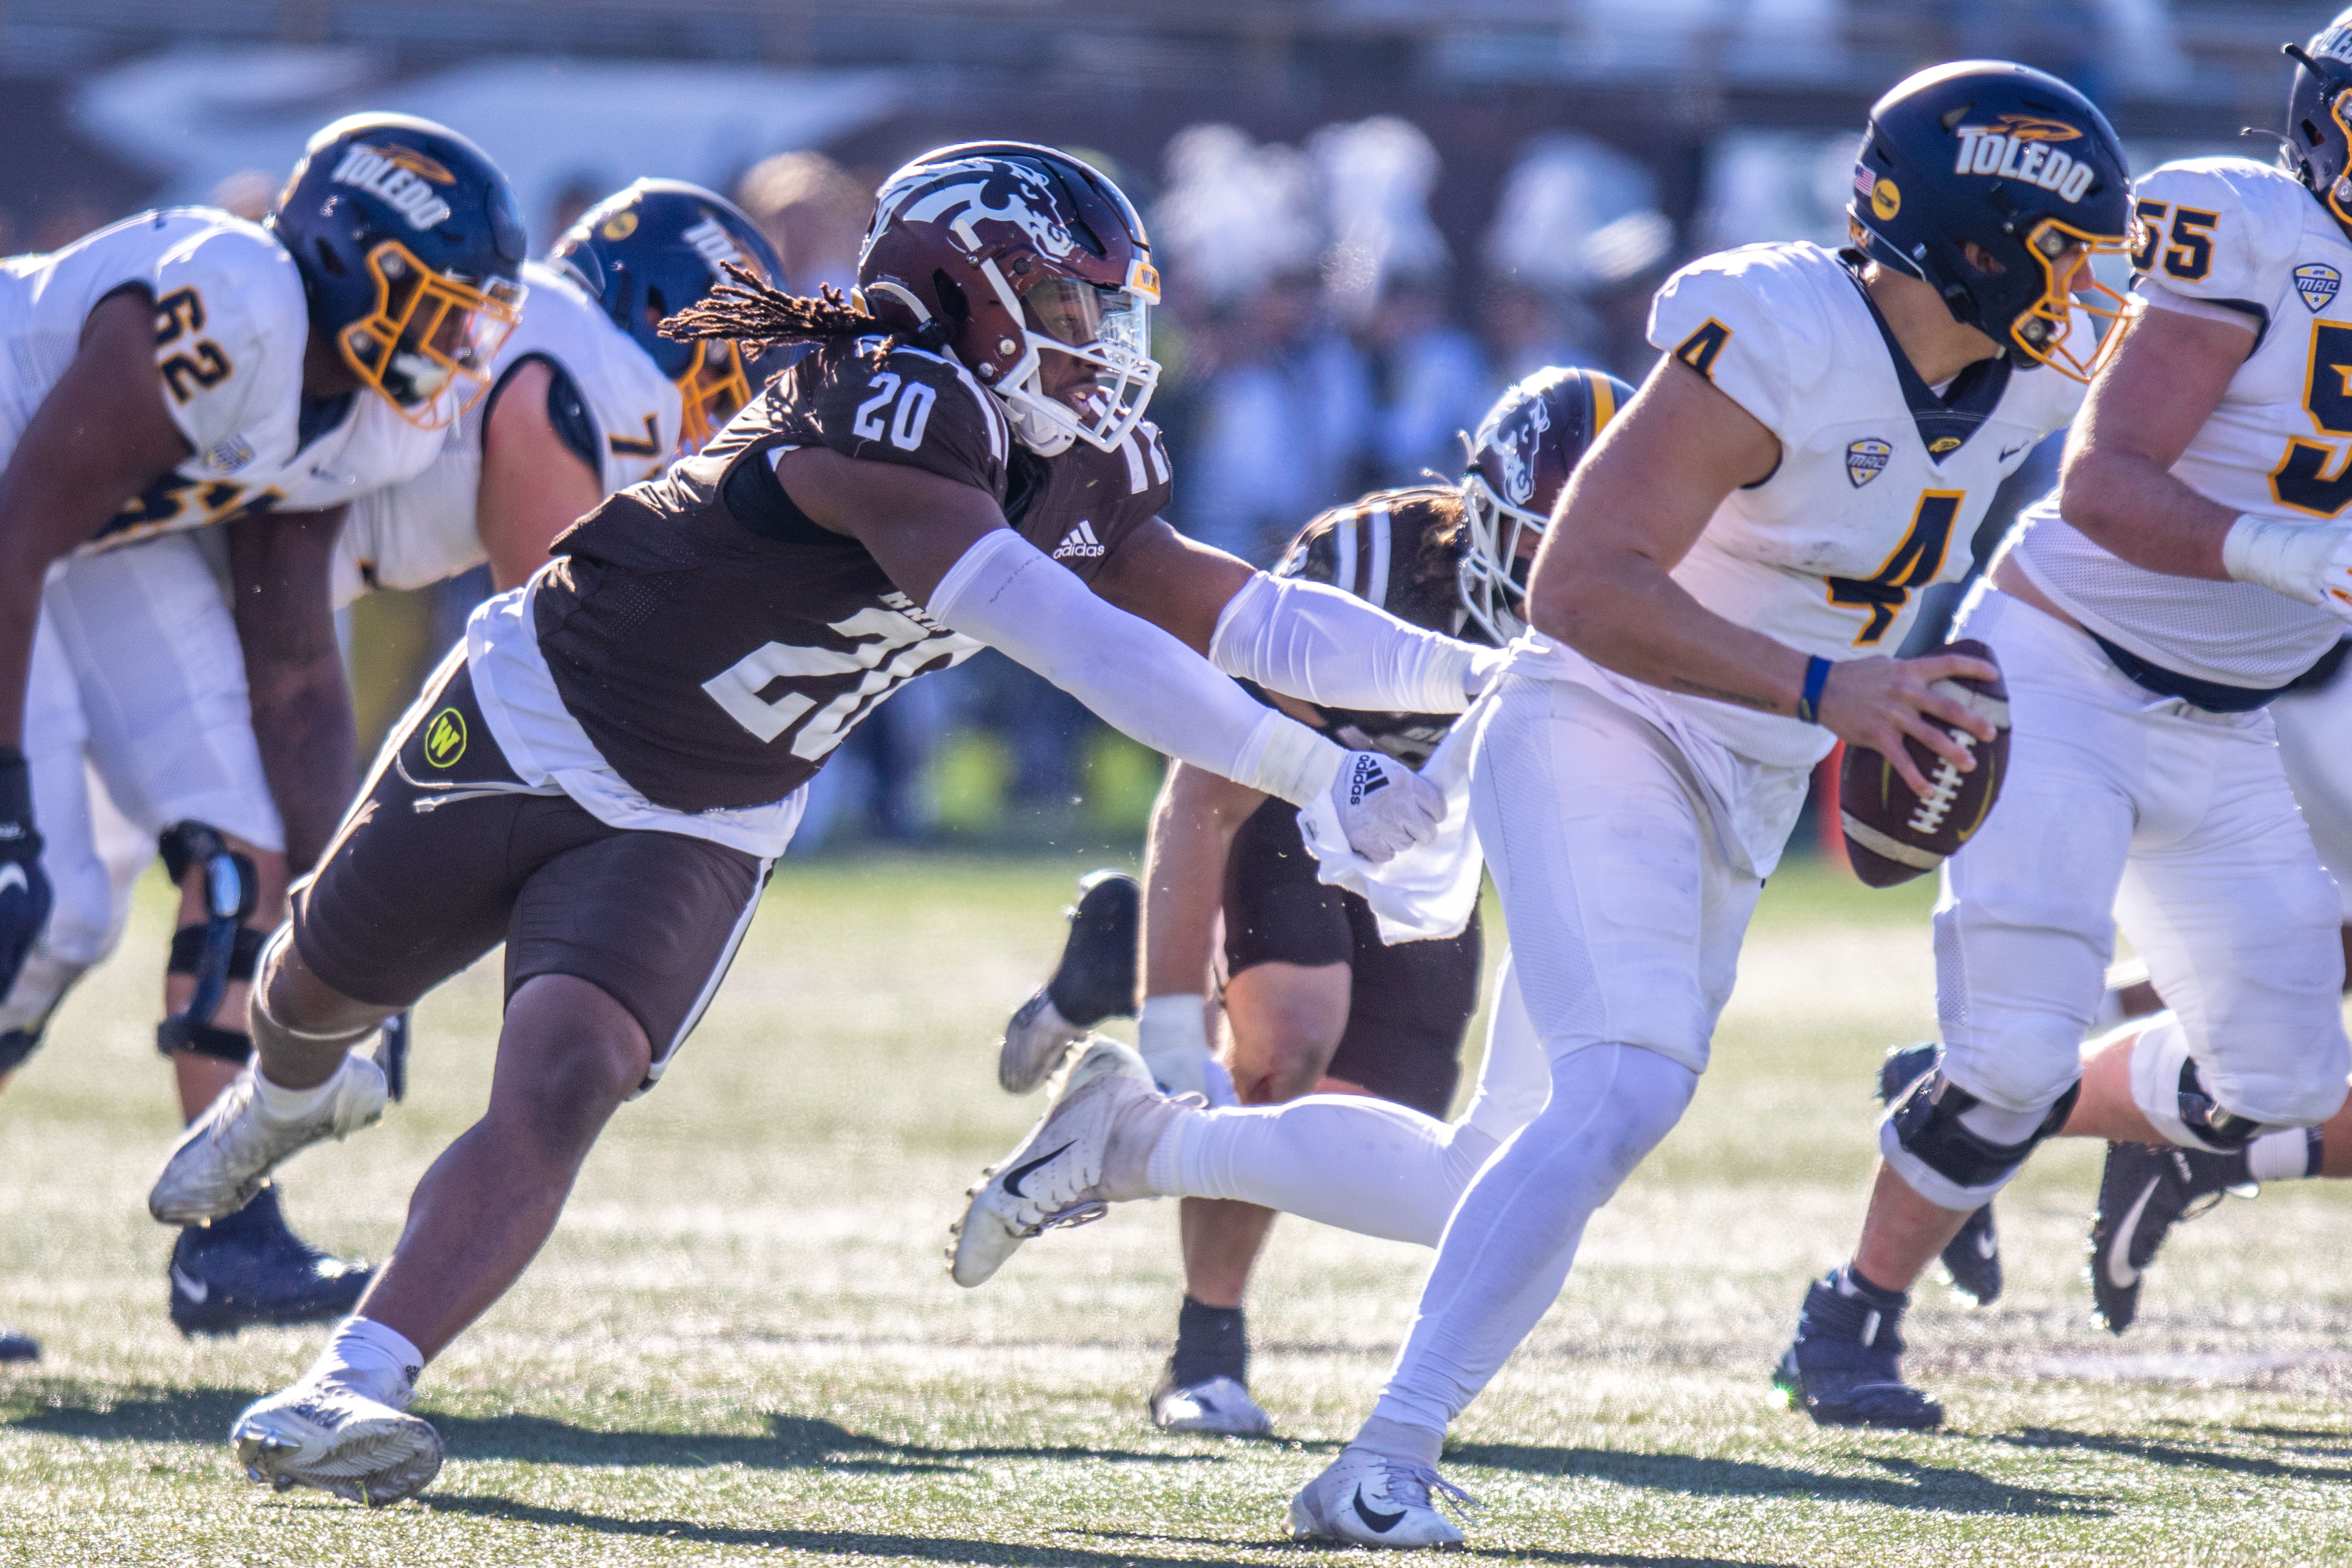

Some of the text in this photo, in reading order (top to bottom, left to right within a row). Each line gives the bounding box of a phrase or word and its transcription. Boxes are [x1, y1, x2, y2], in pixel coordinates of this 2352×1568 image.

[331, 143, 451, 231] TOLEDO
[1956, 125, 2095, 204] TOLEDO
[2131, 198, 2220, 282] 55
[2297, 277, 2339, 294] MAC
[155, 285, 235, 407] 62
[1675, 316, 1734, 383] 4
[852, 372, 937, 452] 20
[1052, 542, 1105, 560] adidas
[1823, 488, 1967, 646] 4
[700, 606, 996, 762] 20
[430, 716, 461, 759] W
[1350, 754, 1370, 806] adidas
